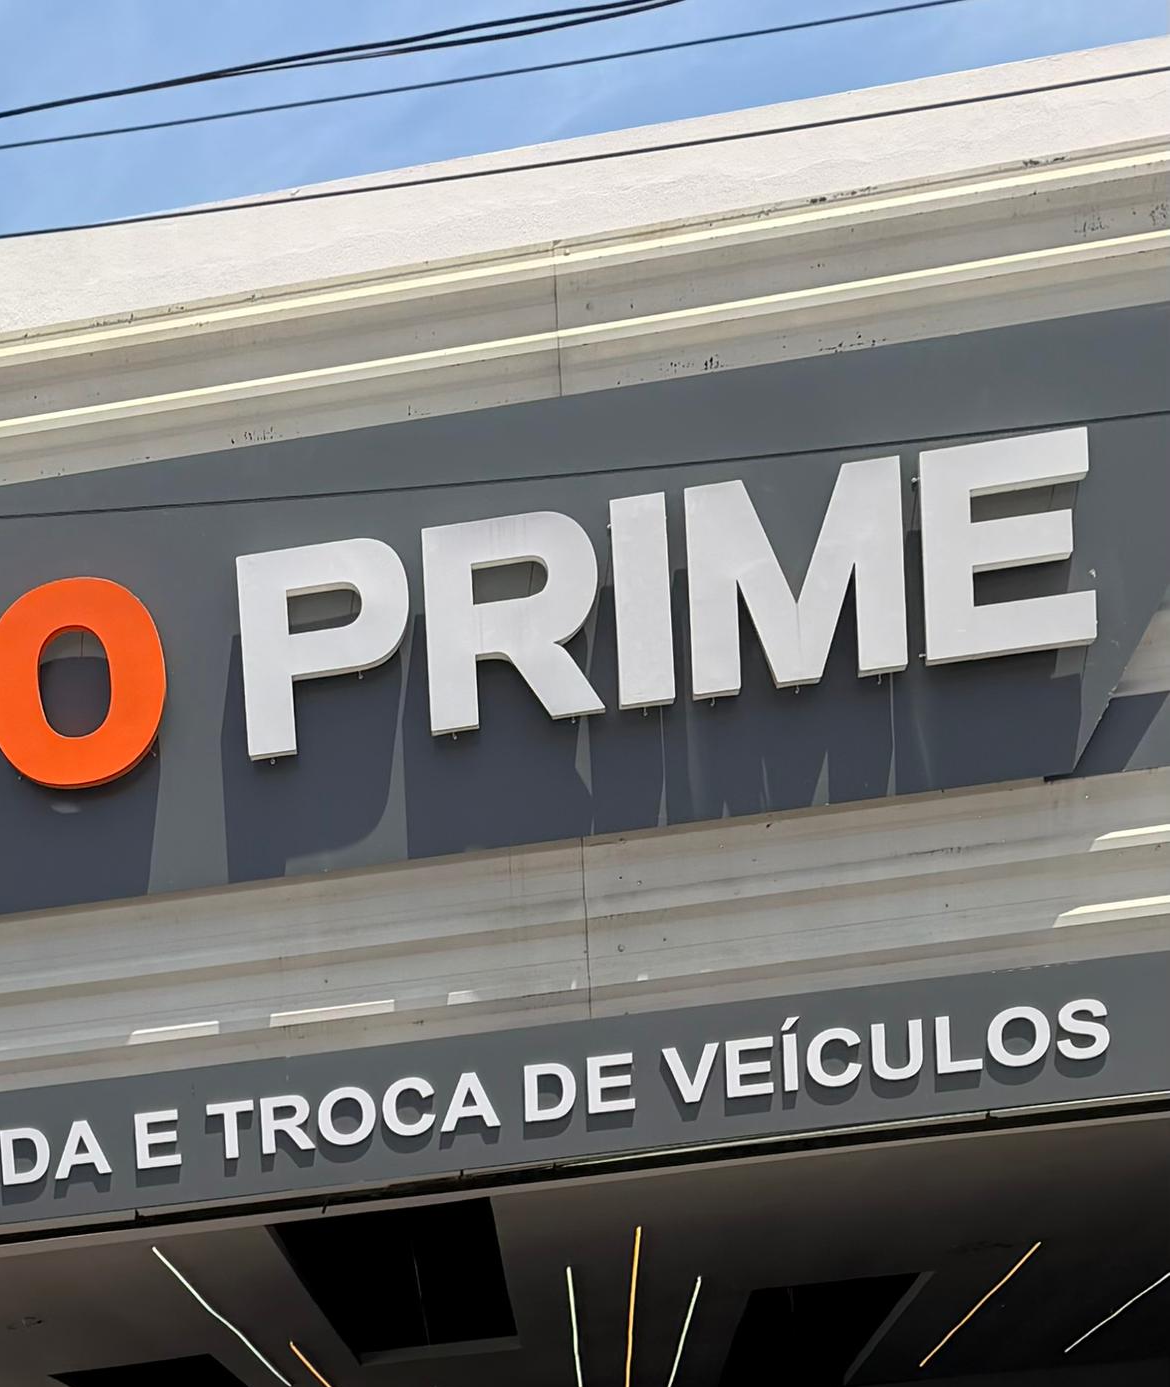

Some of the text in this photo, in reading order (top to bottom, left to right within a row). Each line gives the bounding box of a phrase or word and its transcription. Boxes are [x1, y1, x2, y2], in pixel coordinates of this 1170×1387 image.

[235, 426, 1098, 761] PRIME
[133, 1108, 182, 1169] E
[206, 1070, 501, 1160] TROCA
[523, 1051, 637, 1124] DE
[661, 997, 1111, 1104] VEÍCULOS
